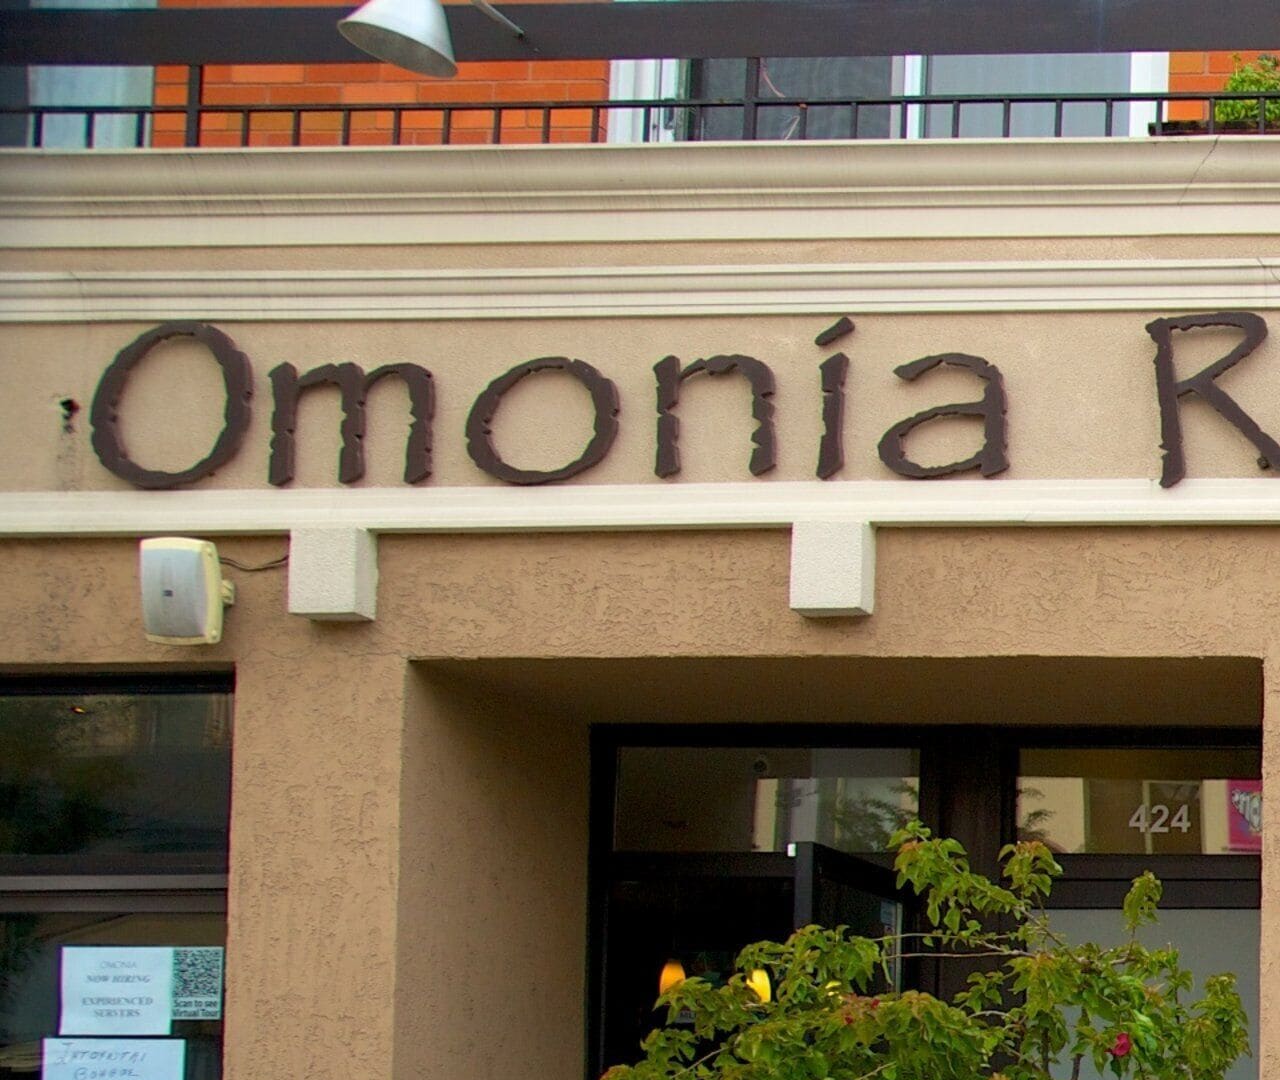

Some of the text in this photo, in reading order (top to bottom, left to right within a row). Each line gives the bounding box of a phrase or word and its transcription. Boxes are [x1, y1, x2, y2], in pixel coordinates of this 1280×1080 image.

[1128, 804, 1192, 833] 424
[111, 974, 153, 984] HIRING
[173, 999, 218, 1008] Scan to see
[201, 1008, 219, 1018] Tour
